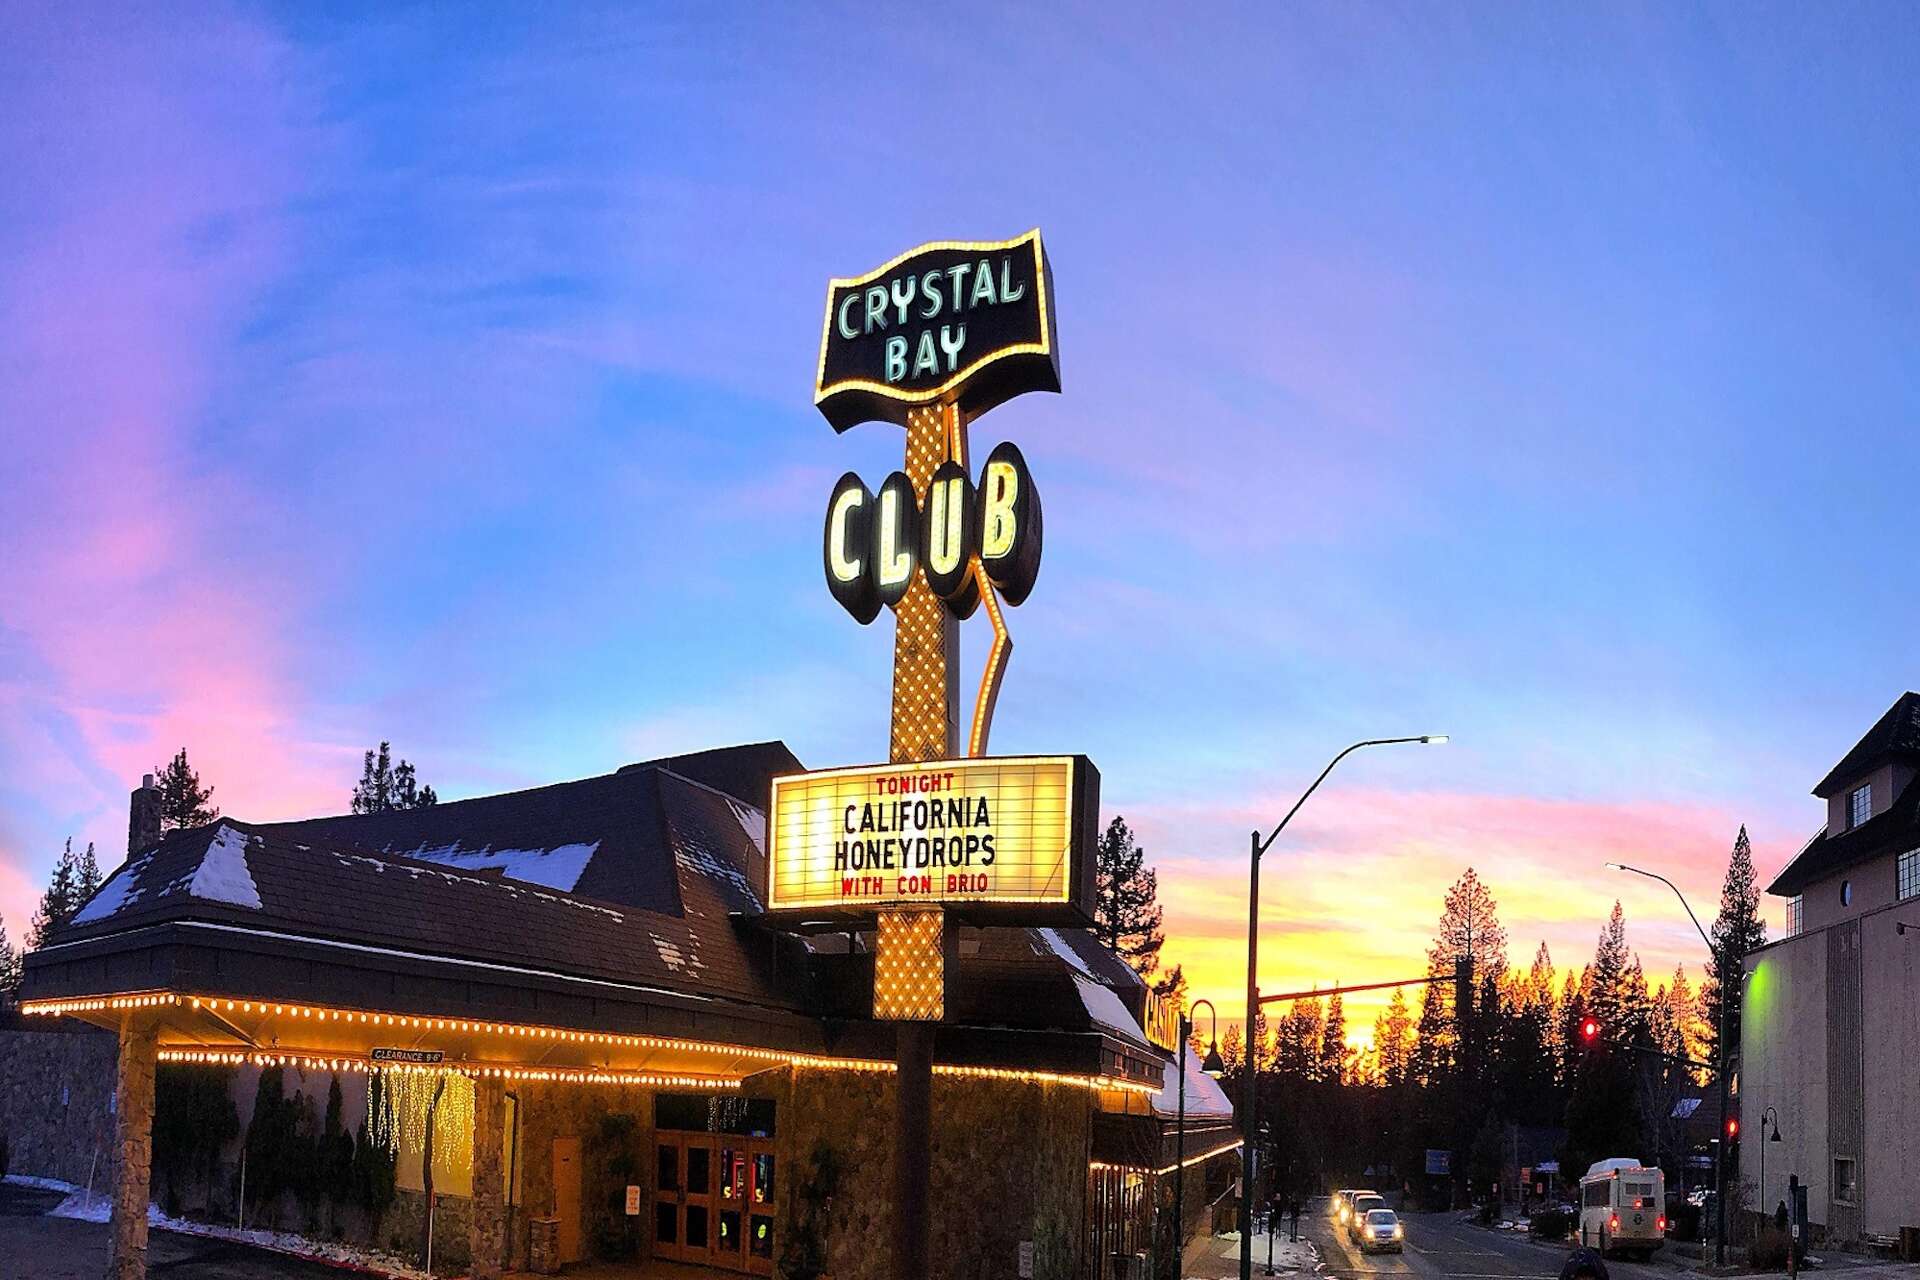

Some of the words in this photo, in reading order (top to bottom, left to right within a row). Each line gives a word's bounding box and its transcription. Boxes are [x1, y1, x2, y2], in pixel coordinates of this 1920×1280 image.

[838, 256, 1025, 340] CRYSTAL
[885, 322, 966, 383] BAY
[830, 462, 1019, 586] CLUB
[876, 773, 954, 796] TONIGHT
[844, 796, 990, 834] CALIFORNIA
[834, 834, 996, 871] HONEYDROPS
[841, 876, 883, 896] WITH
[897, 875, 932, 895] CON
[947, 873, 988, 893] BRIO
[375, 1050, 423, 1062] CLEARANCE
